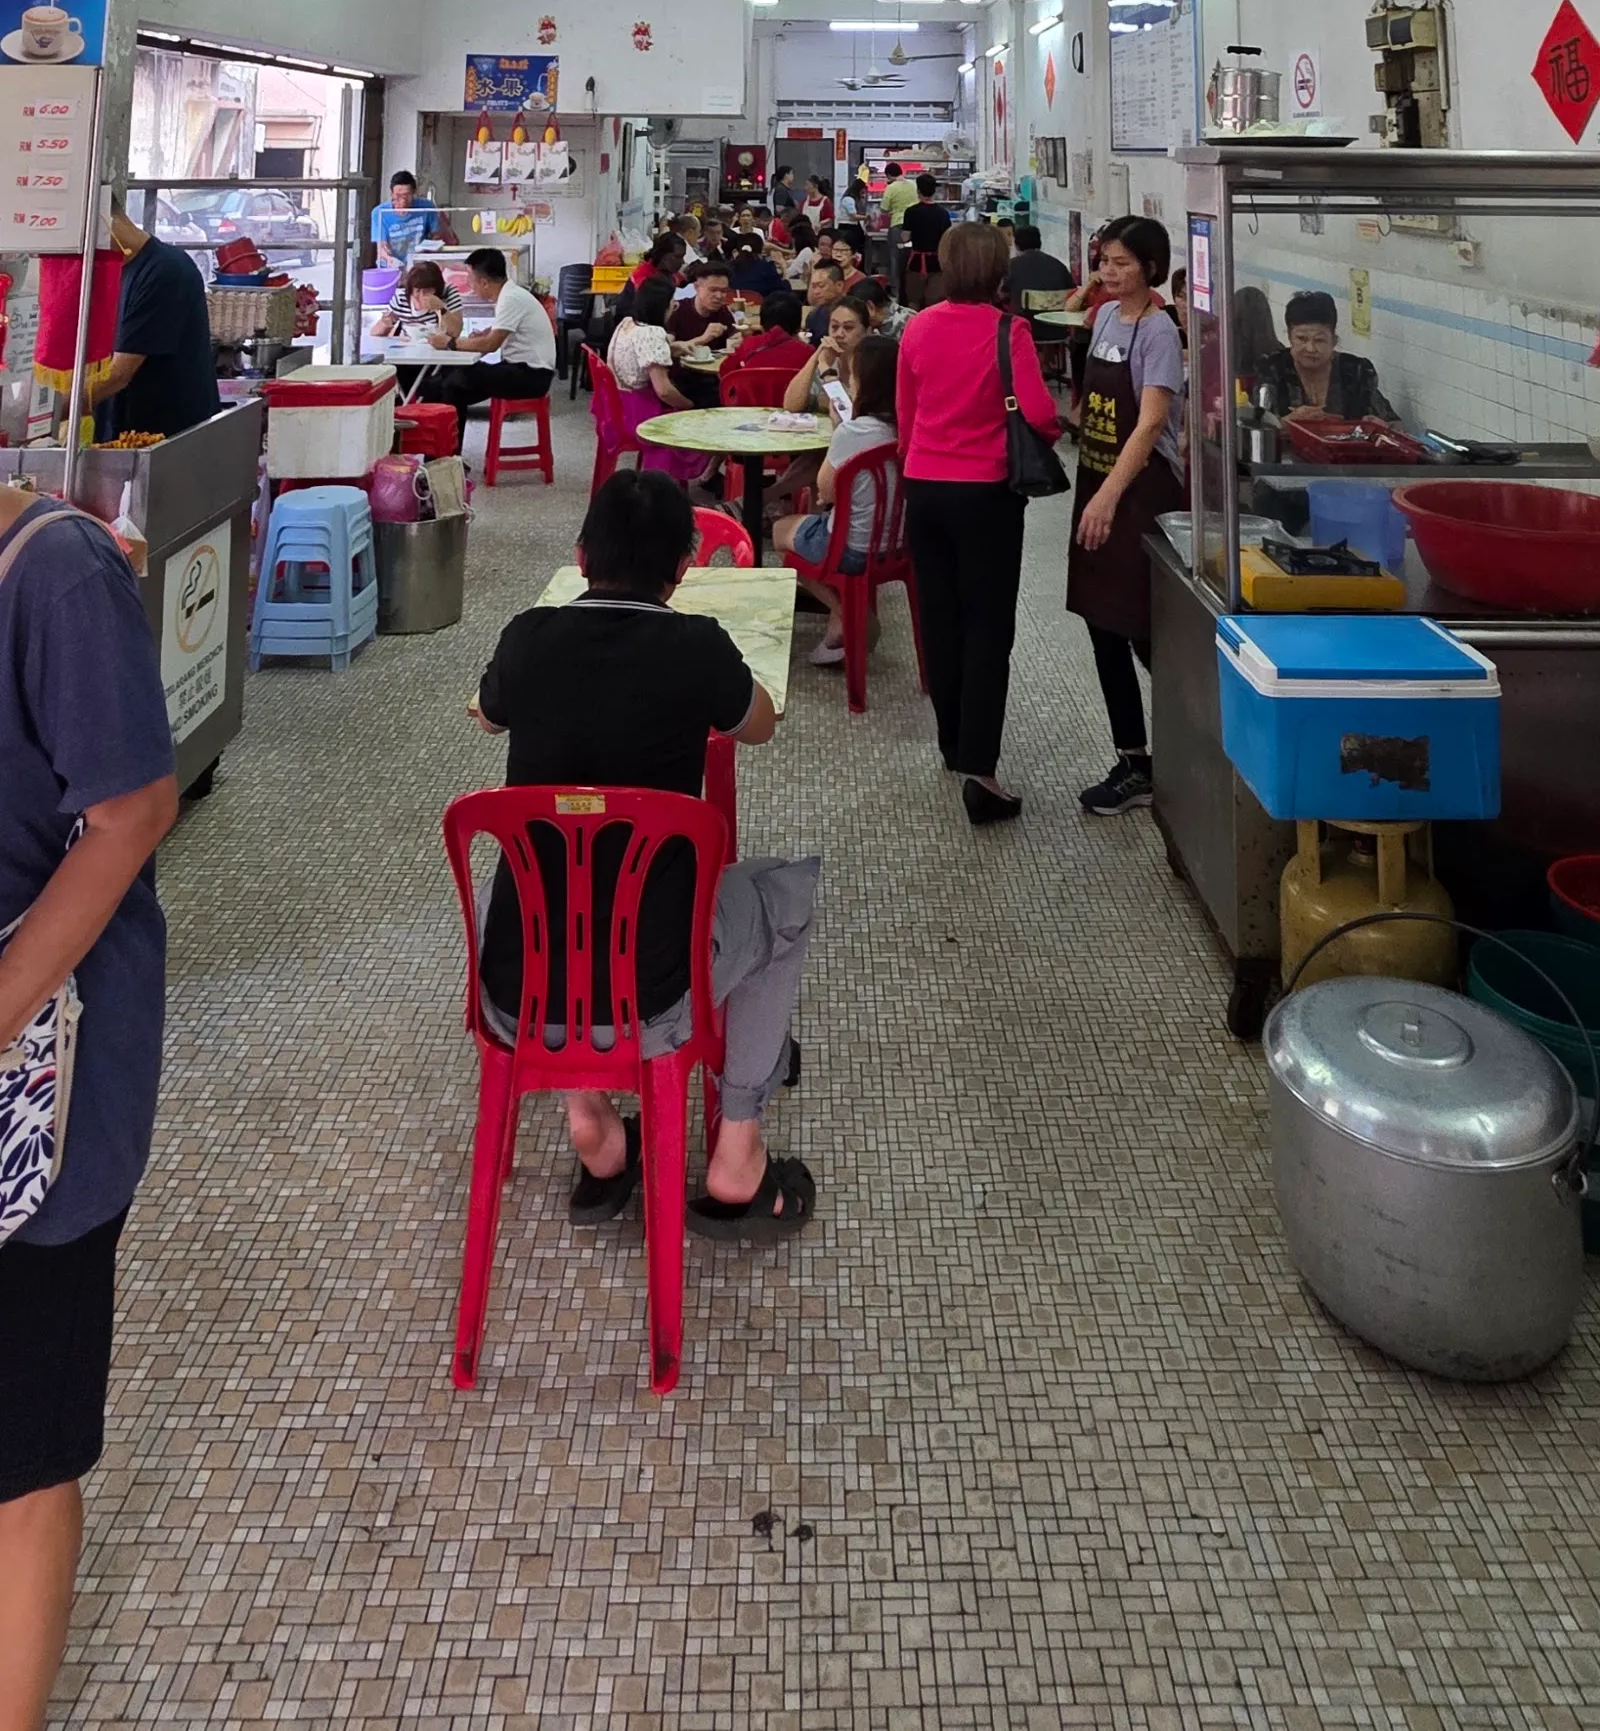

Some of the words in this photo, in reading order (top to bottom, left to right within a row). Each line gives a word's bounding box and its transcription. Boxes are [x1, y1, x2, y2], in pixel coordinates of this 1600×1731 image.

[1549, 37, 1590, 104] 福
[476, 77, 523, 97] 水果
[39, 104, 69, 115] 6.00
[37, 139, 69, 149] 5.50
[32, 175, 63, 186] 7.50
[29, 215, 57, 227] 7.00
[197, 641, 224, 672] MEROKOK
[183, 683, 218, 725] SMOKING
